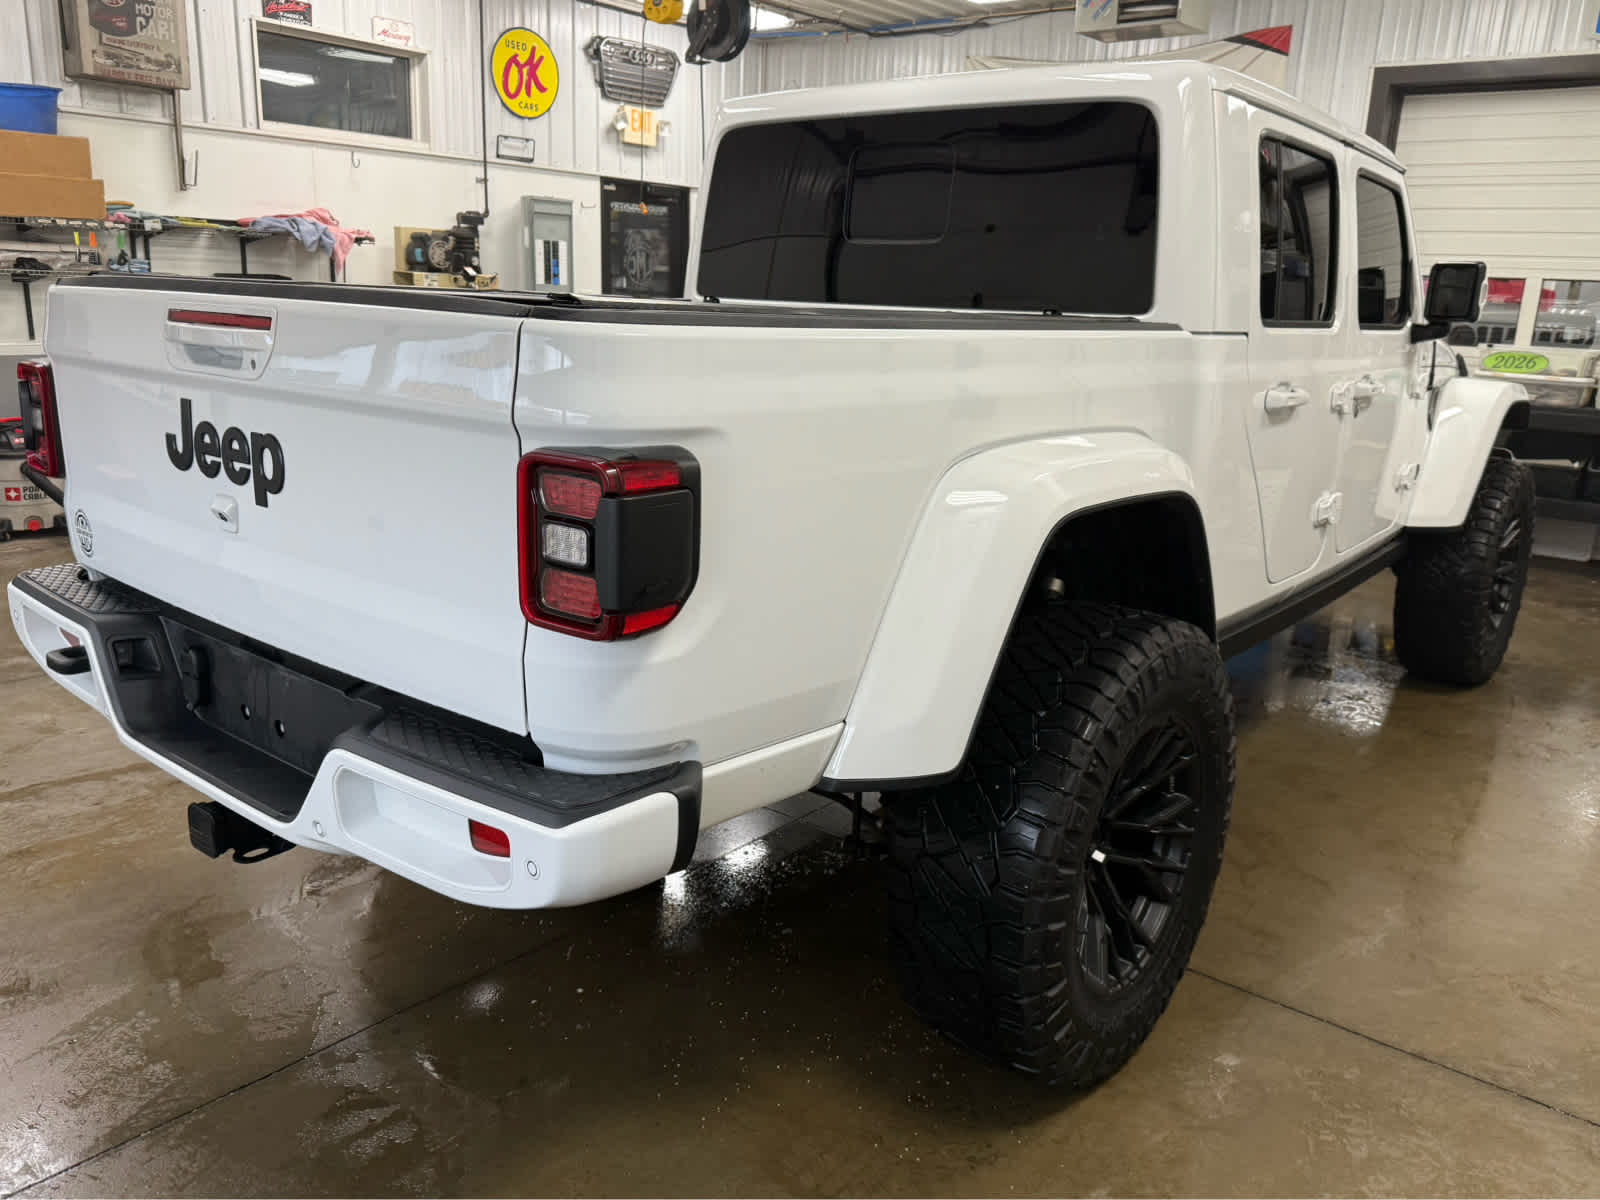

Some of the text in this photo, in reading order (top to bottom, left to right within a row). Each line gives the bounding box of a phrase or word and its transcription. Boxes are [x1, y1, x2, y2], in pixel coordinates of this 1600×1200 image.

[136, 3, 174, 20] MOTOR
[504, 39, 528, 52] USED
[502, 45, 548, 100] OK
[518, 101, 539, 113] CARS
[1491, 355, 1537, 370] 2026
[165, 397, 285, 508] Jeep
